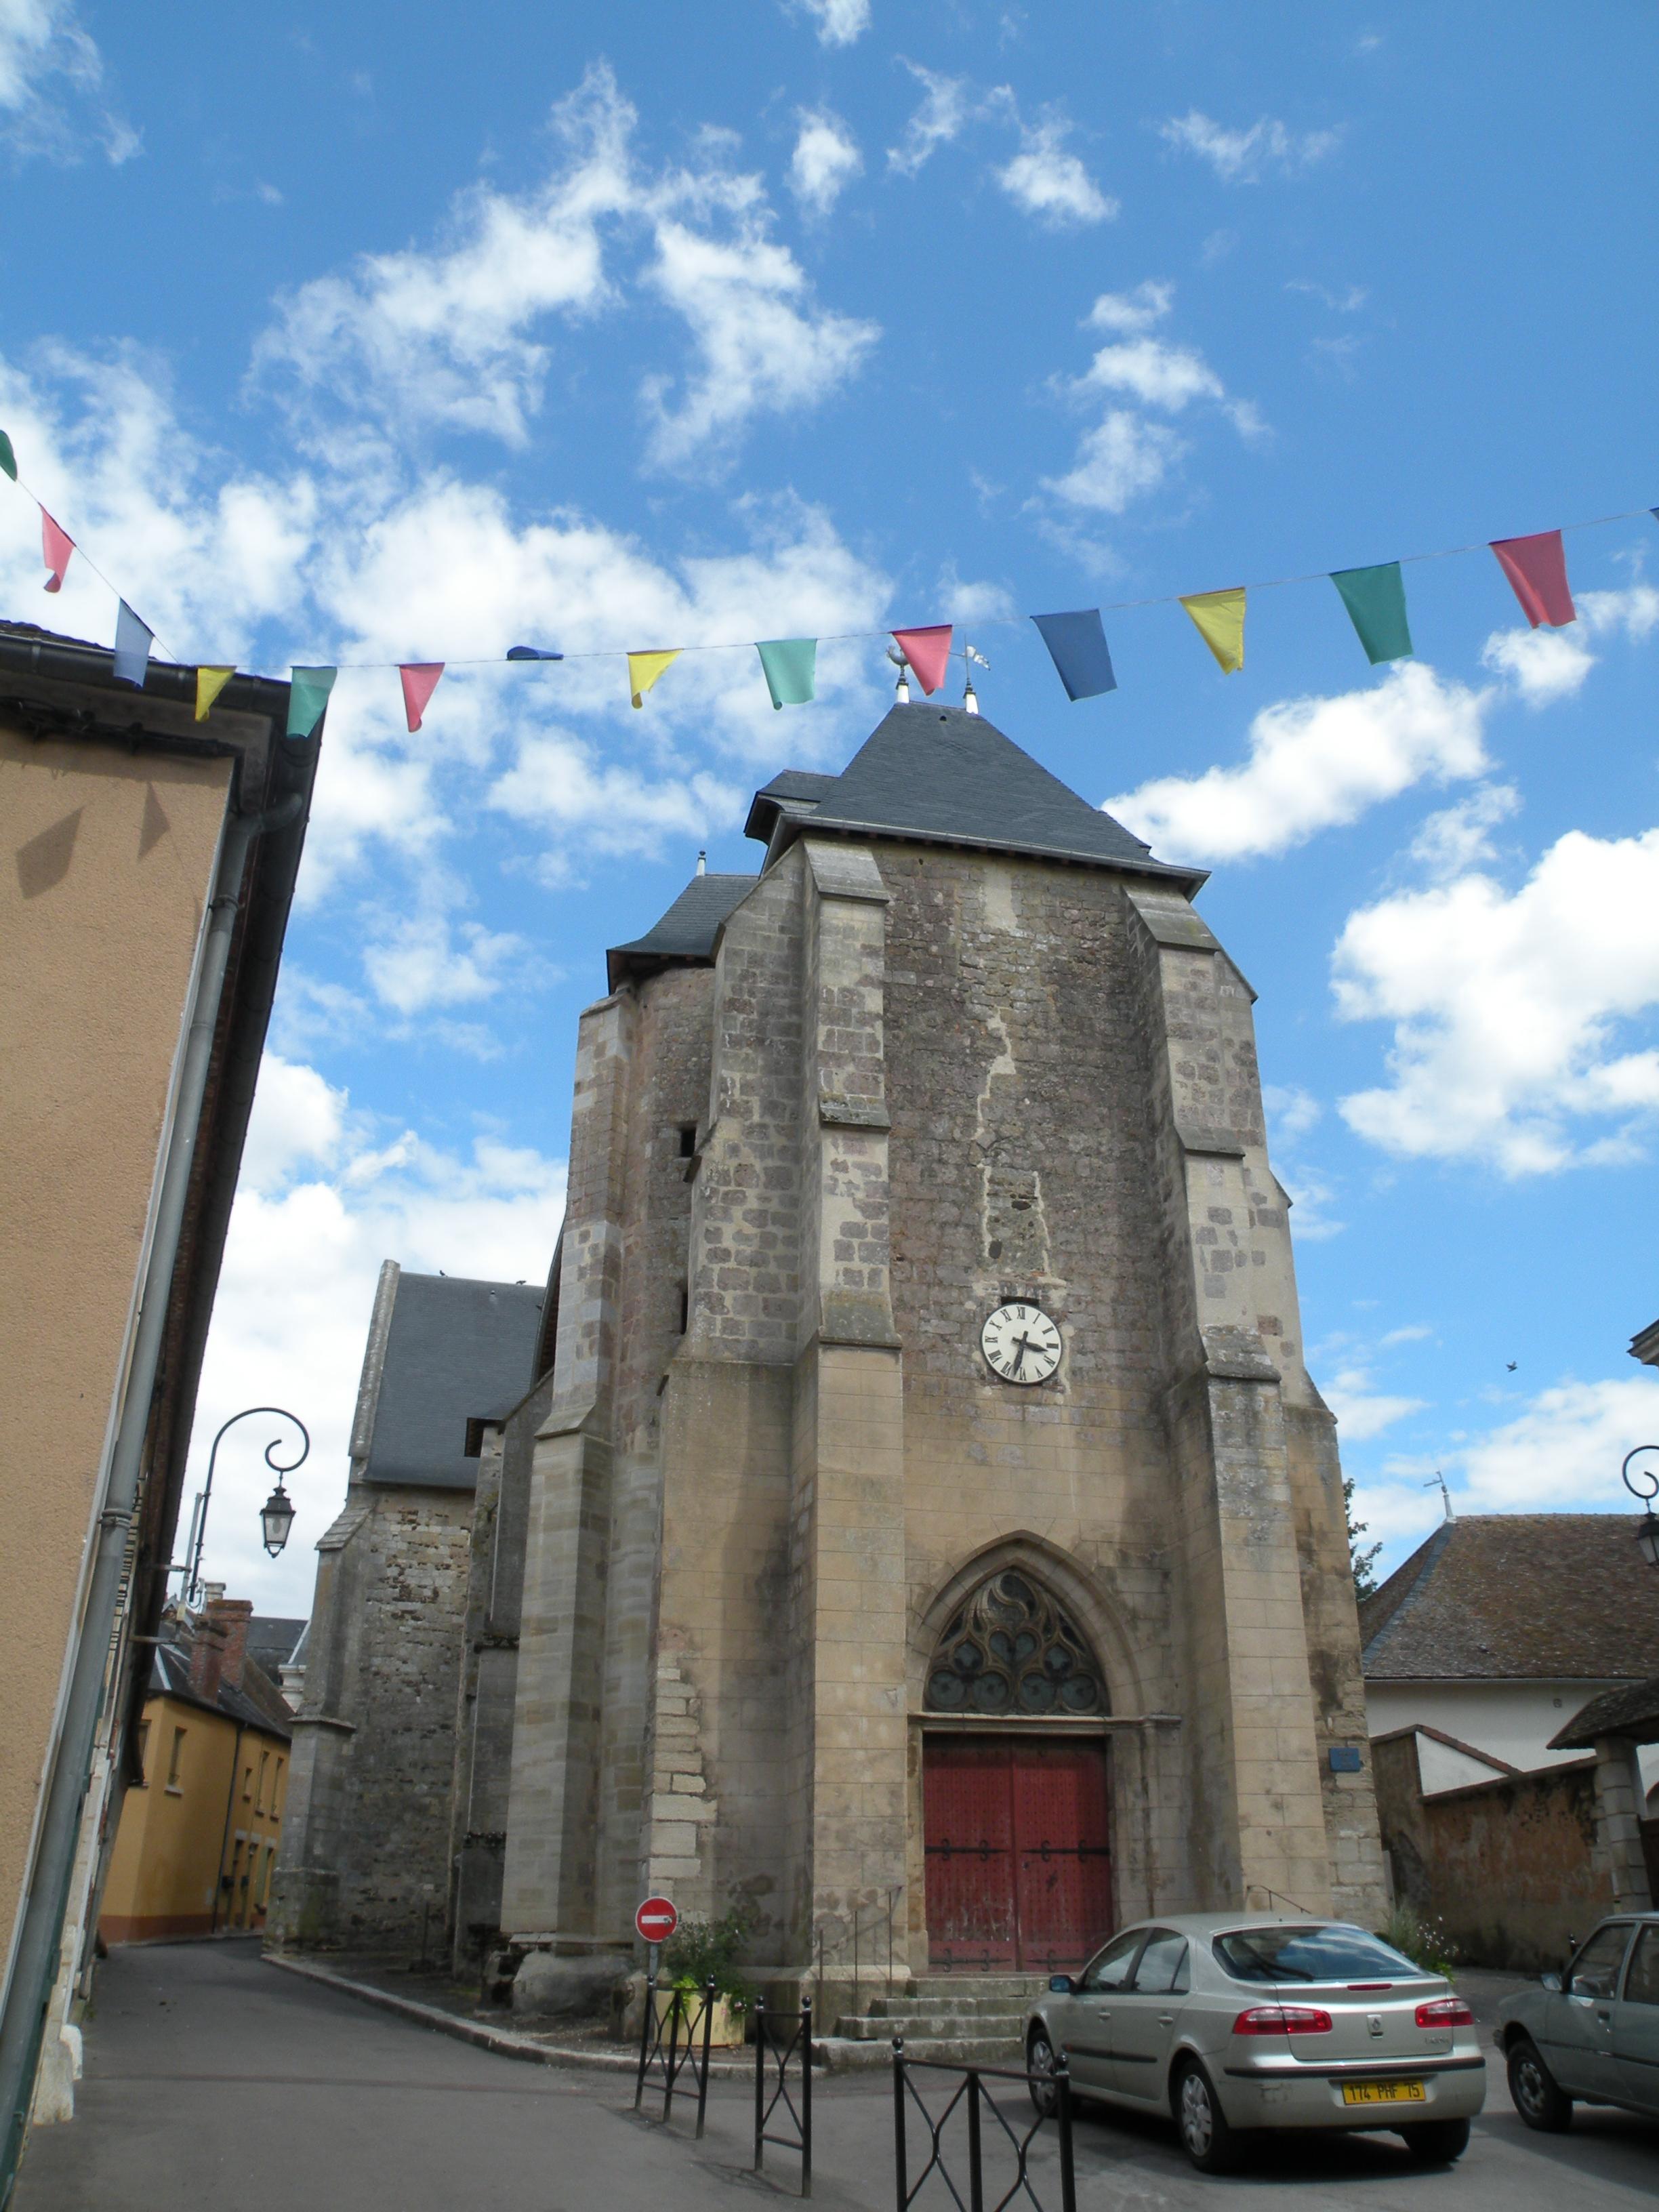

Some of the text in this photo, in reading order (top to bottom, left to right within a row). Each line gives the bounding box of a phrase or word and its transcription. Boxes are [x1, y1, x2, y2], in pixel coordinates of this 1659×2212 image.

[1000, 1309, 1012, 1322] XI
[1017, 1306, 1025, 1320] XII
[1033, 1313, 1041, 1324] I
[989, 1320, 1002, 1331] X
[985, 1335, 998, 1343] IX
[1000, 1361, 1013, 1376] VII
[1019, 1366, 1027, 1381] VI
[1035, 1365, 1044, 1378] V
[1349, 2082, 1420, 2101] 174 PHF 75
